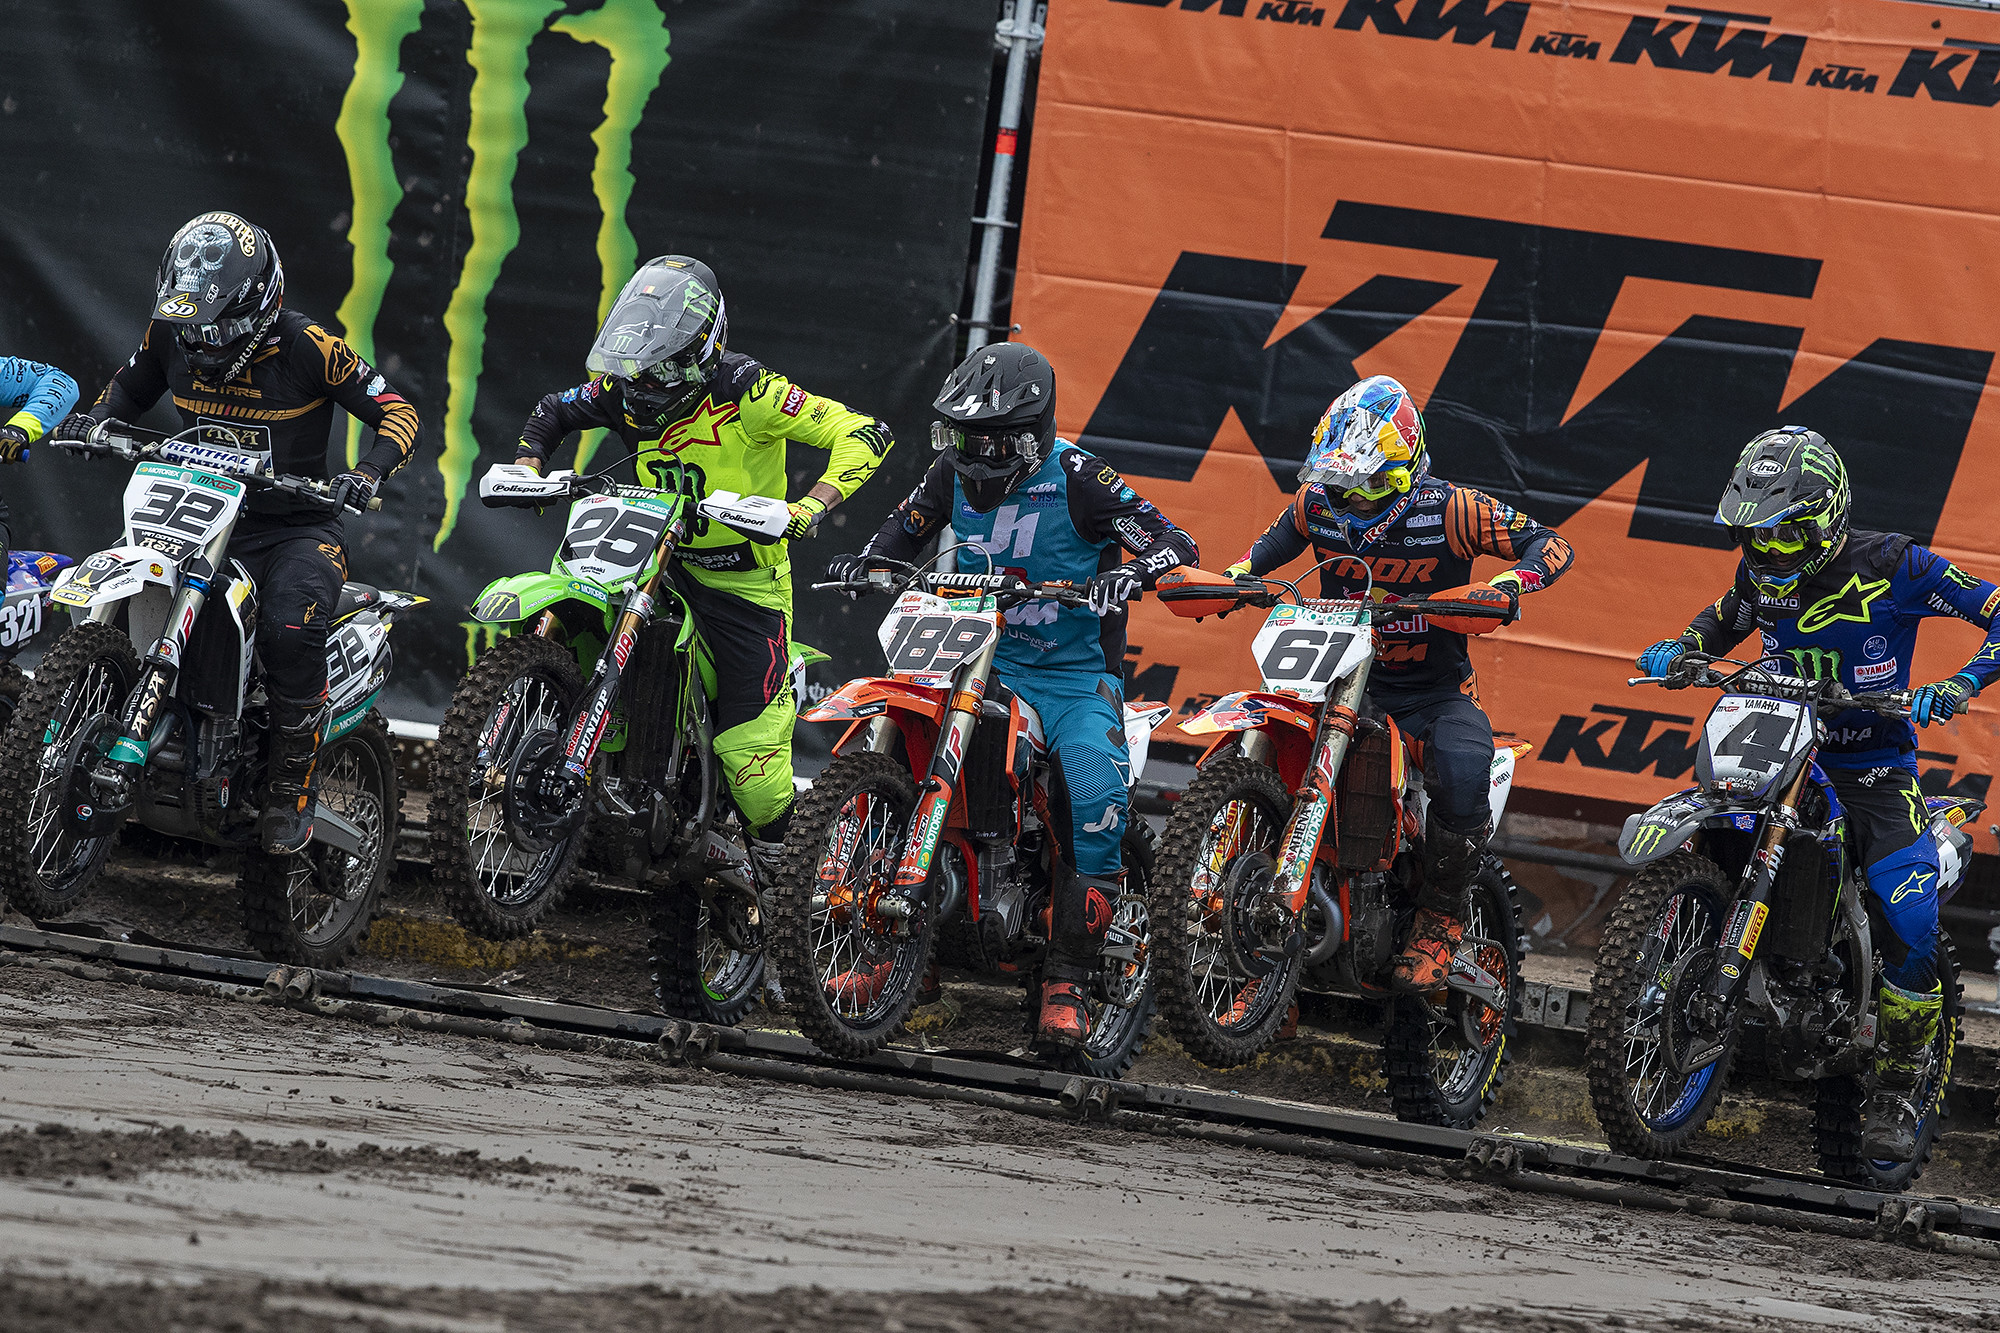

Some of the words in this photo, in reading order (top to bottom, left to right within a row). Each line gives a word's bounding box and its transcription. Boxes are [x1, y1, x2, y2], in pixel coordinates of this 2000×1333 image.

[1256, 0, 1324, 27] KTM
[1529, 31, 1601, 61] KTM
[1609, 6, 1809, 83] KTM
[1806, 63, 1879, 93] KTM
[1079, 200, 1996, 548] KTM
[784, 387, 803, 413] NGK
[206, 425, 260, 446] ASA
[167, 442, 250, 465] RENTHAL
[1332, 461, 1353, 472] Bull
[147, 467, 181, 477] MOTOREX
[1751, 461, 1779, 473] Arai
[197, 475, 237, 491] MXGP
[493, 484, 546, 494] Polisport
[1027, 482, 1057, 493] KTM
[131, 481, 226, 537] 32
[720, 511, 766, 526] Polisport
[559, 507, 665, 567] 25
[1320, 528, 1345, 539] MOTOR
[1363, 508, 1399, 544] Red
[139, 537, 183, 555] ASA
[1317, 547, 1439, 583] THOR
[580, 584, 608, 602] MOTOREX
[960, 600, 995, 608] MOTOEX
[1467, 589, 1502, 601] KTM
[1759, 594, 1799, 608] WILVO
[0, 594, 42, 648] 321
[890, 606, 921, 614] MXGP
[1264, 619, 1295, 629] MXGP
[1382, 615, 1428, 633] Bull
[886, 616, 993, 671] 189
[1261, 630, 1355, 682] 61
[326, 627, 370, 694] 32
[1864, 660, 1896, 675] YAMAHA
[132, 671, 168, 741] ASA
[1744, 699, 1781, 712] YAMAHA
[338, 707, 367, 731] MOTOREX
[577, 689, 608, 761] DUNLOP
[566, 711, 589, 757] BRAKING
[1537, 704, 1703, 783] KTM
[1714, 712, 1796, 773] 4
[923, 800, 946, 852] MOTOREX
[1299, 800, 1328, 862] MOTOREX
[1643, 815, 1679, 827] YAMAHA
[1937, 839, 1962, 889] 4
[1729, 910, 1745, 944] CERTINA
[1743, 906, 1766, 955] PIRELLI
